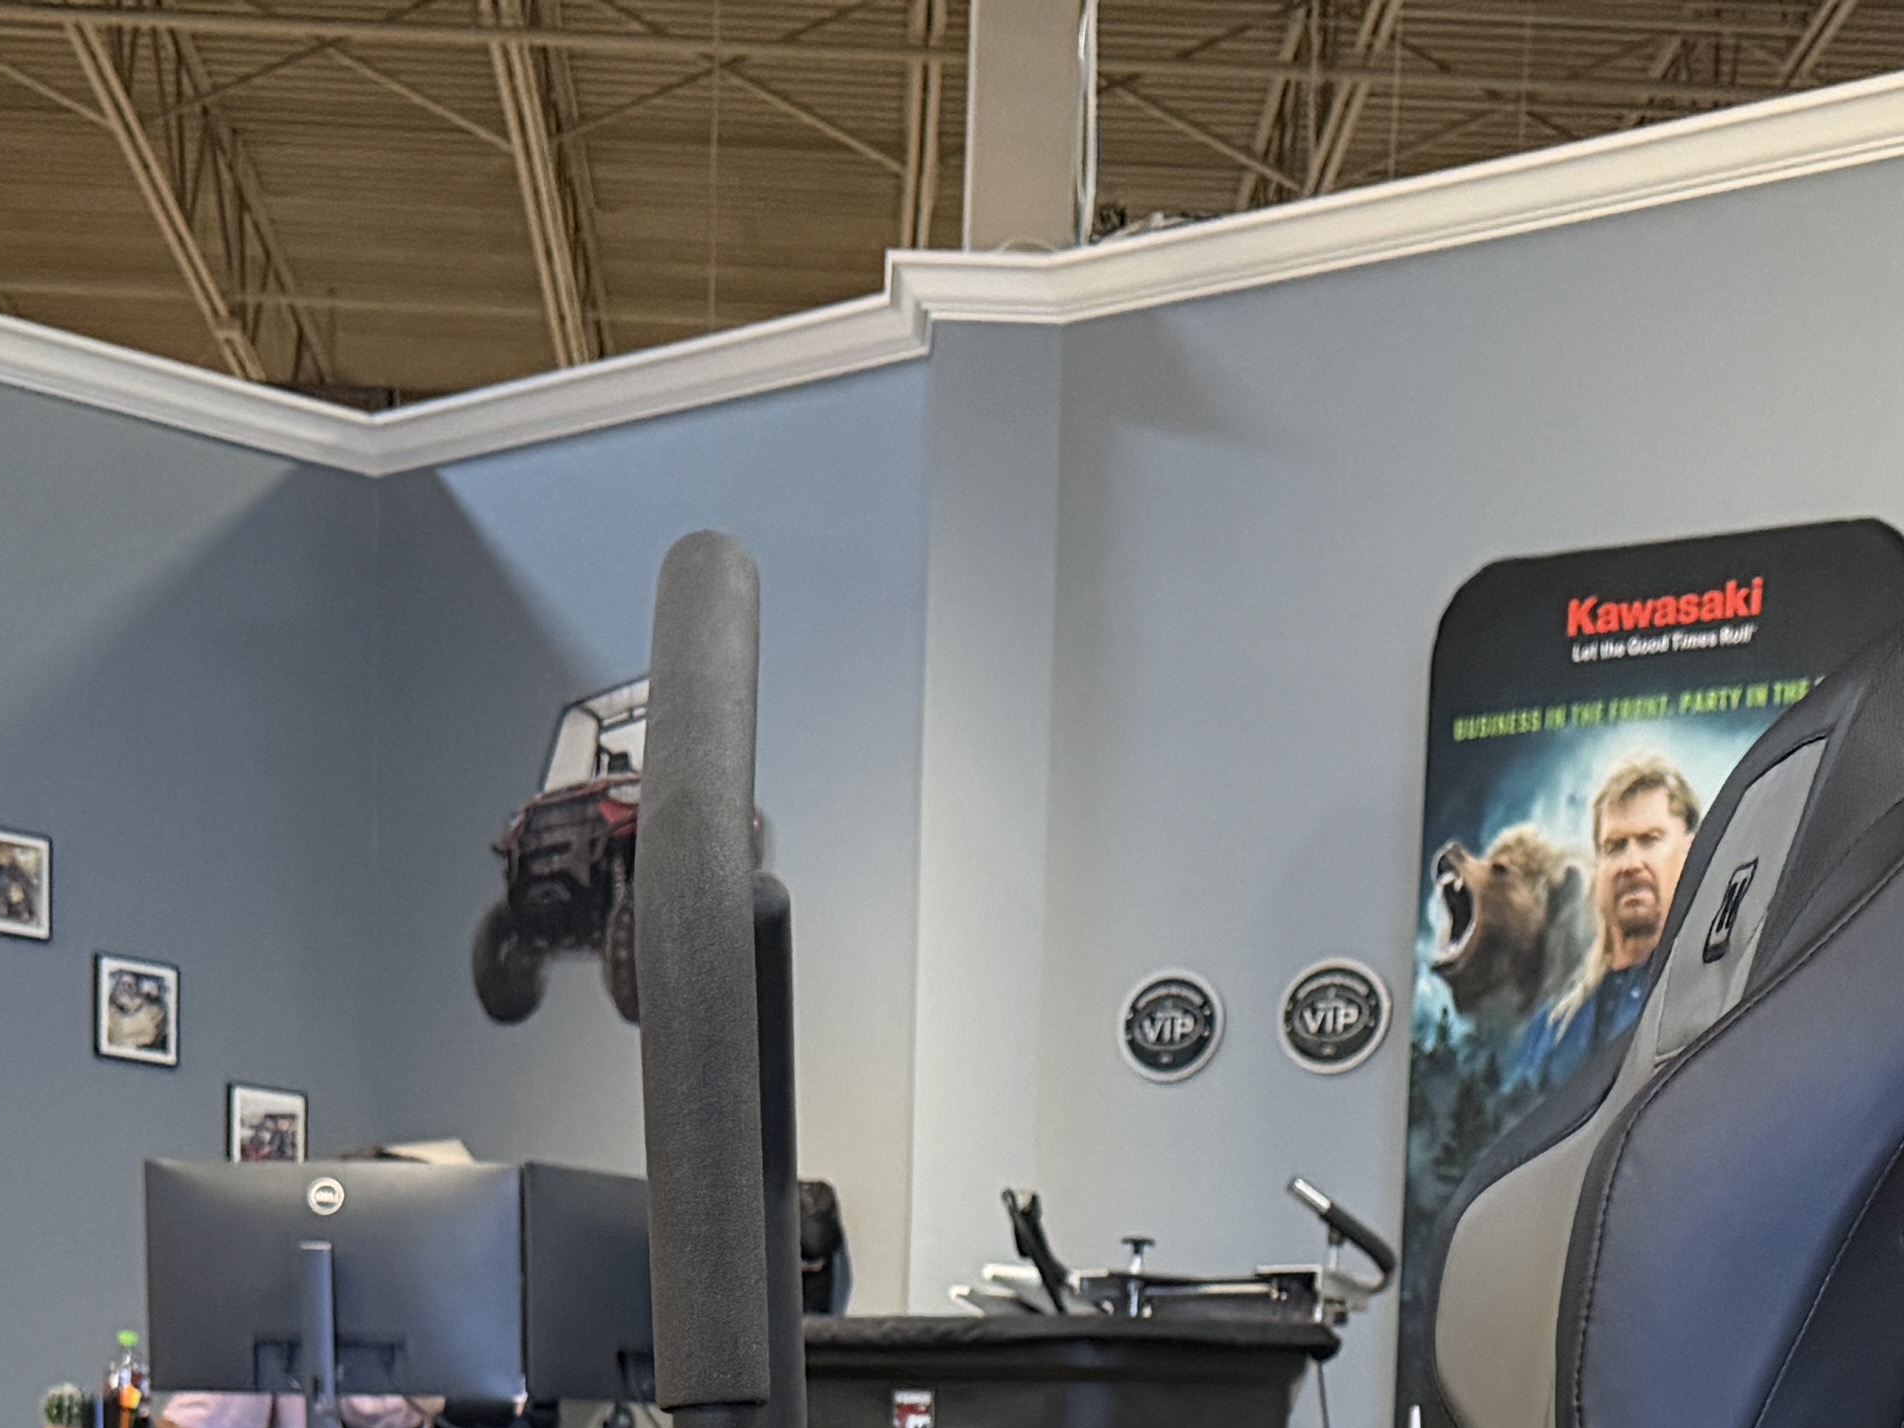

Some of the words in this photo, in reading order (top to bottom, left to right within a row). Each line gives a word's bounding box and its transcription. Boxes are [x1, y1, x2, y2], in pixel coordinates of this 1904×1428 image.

[1566, 576, 1764, 637] Kawasaki
[1572, 642, 1597, 663] Let
[1600, 639, 1625, 660] the
[1627, 636, 1669, 657] Good
[1672, 629, 1717, 652] Times
[1453, 707, 1542, 741] BUSINESS
[1545, 704, 1567, 730] IN
[1571, 700, 1604, 727] THE
[1679, 685, 1743, 716] PARTY
[1746, 681, 1769, 708] IN
[1142, 1012, 1195, 1043] VIP
[1302, 1003, 1359, 1034] VIP
